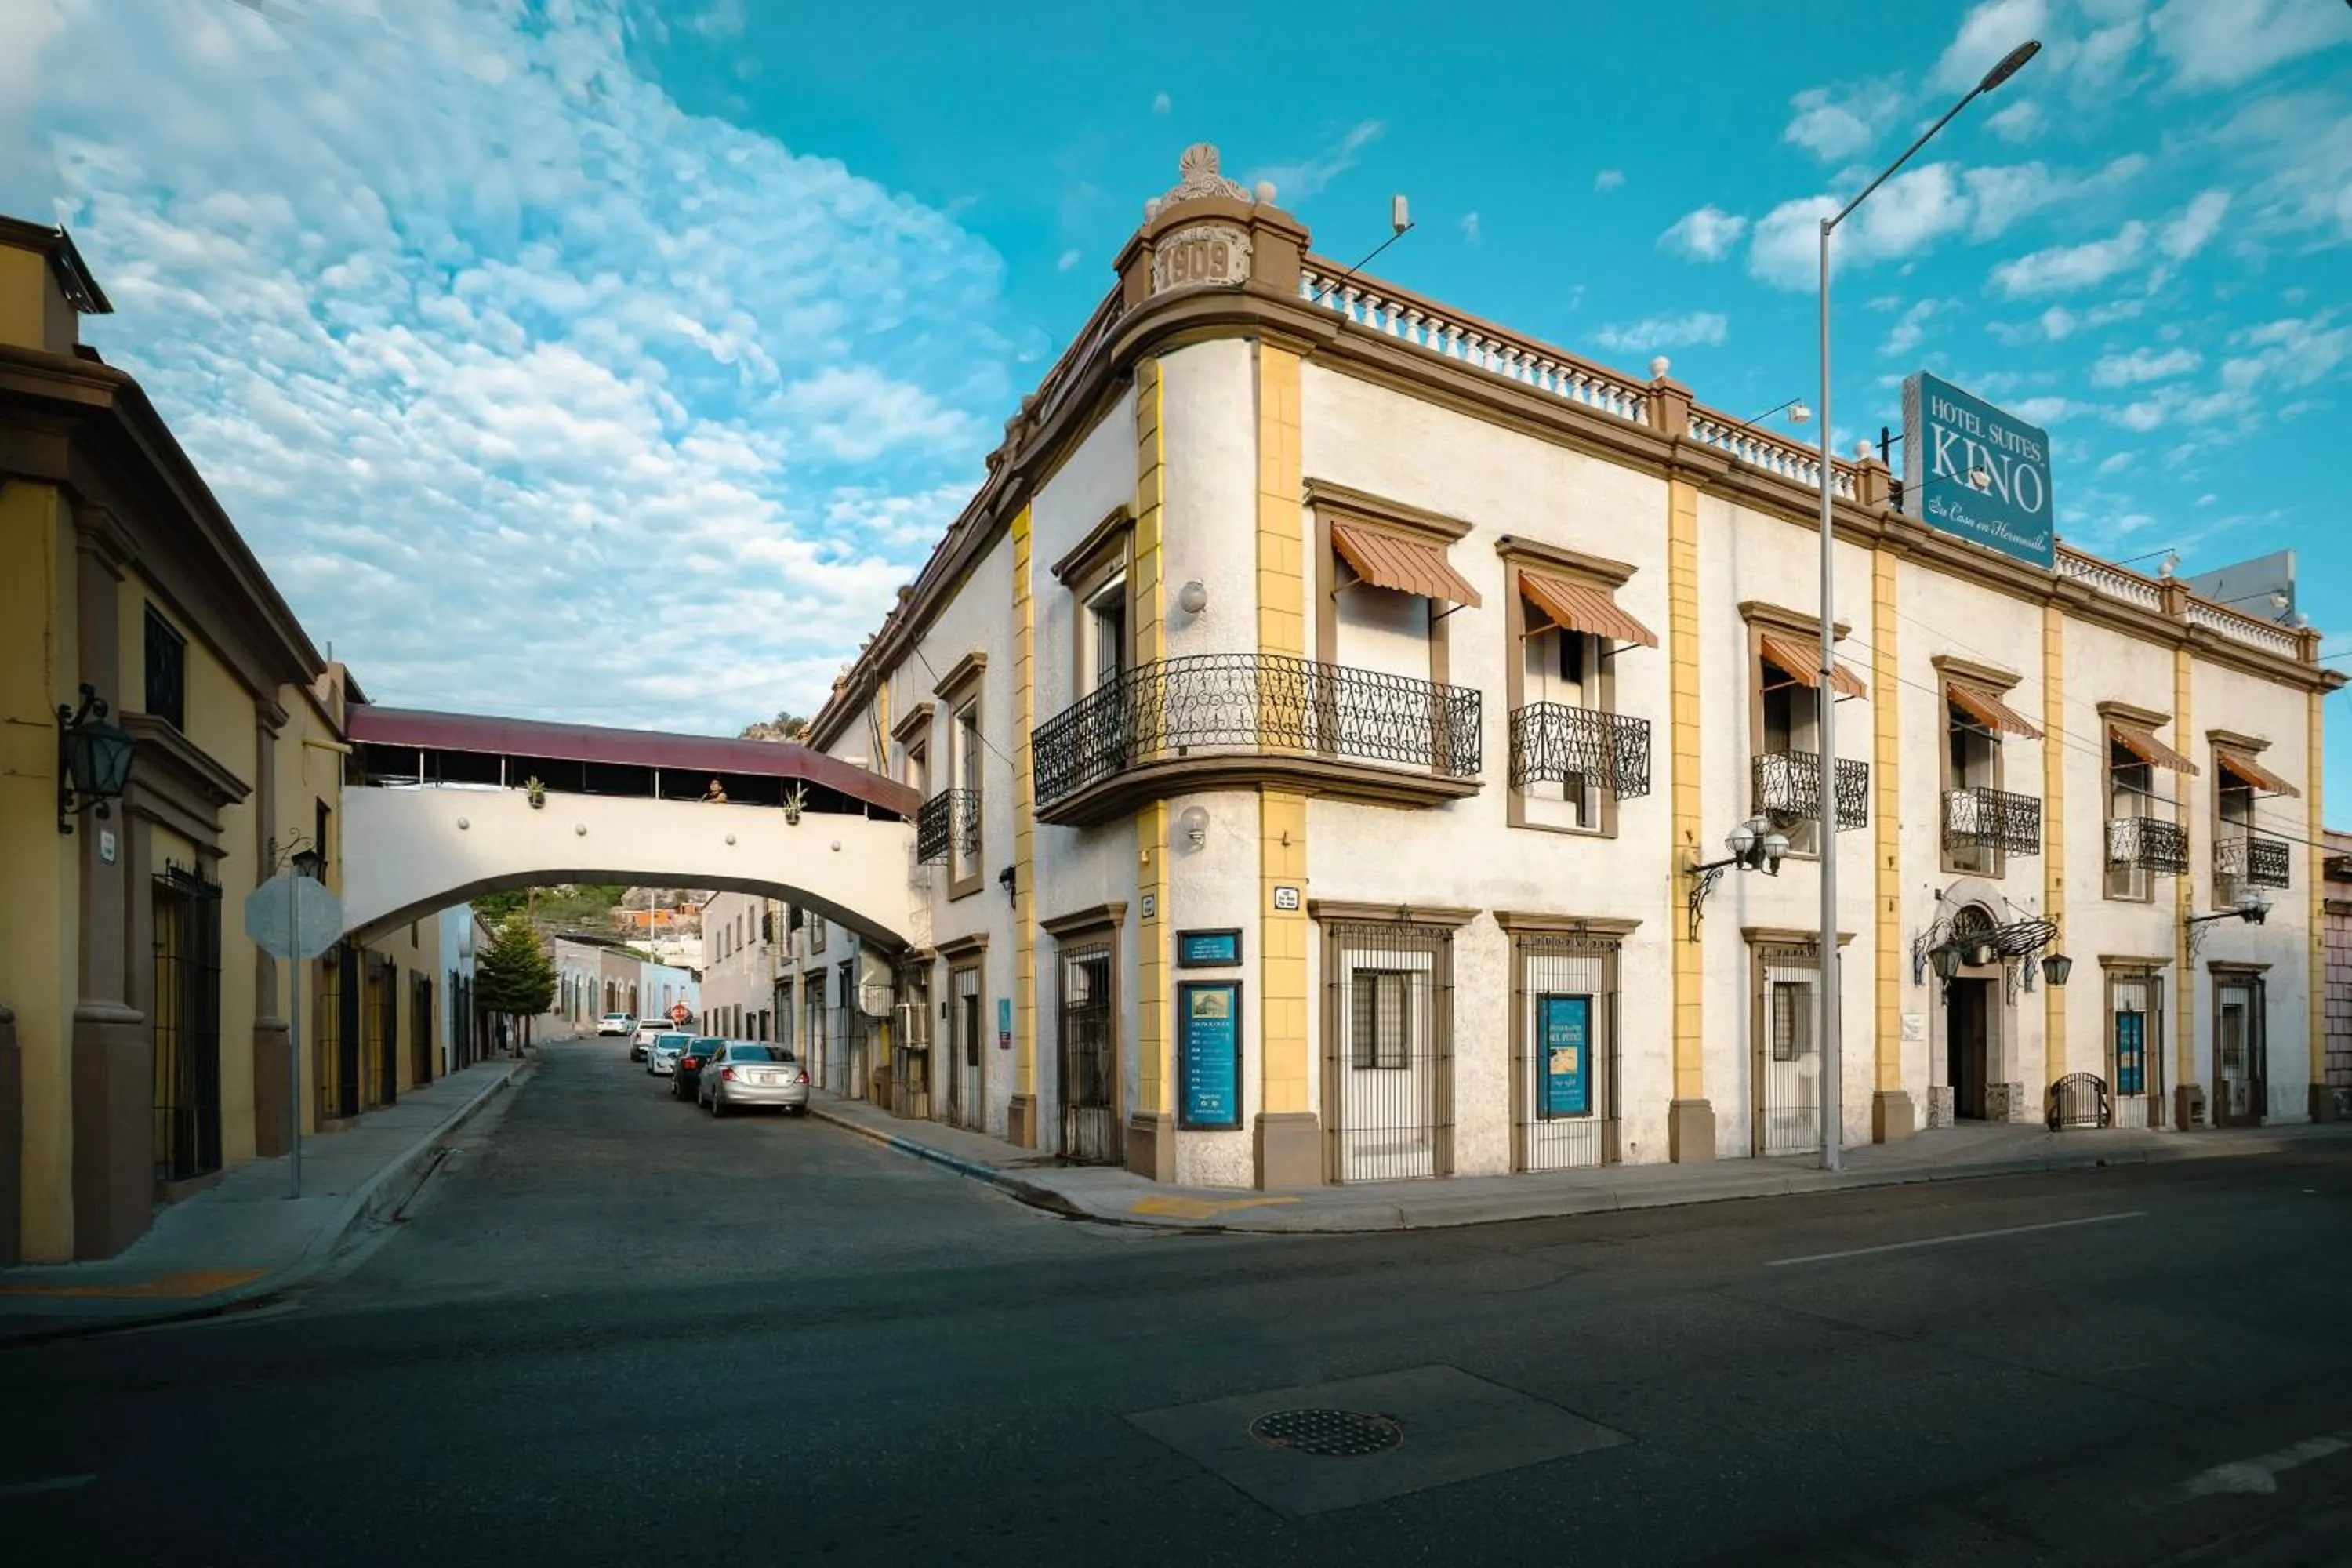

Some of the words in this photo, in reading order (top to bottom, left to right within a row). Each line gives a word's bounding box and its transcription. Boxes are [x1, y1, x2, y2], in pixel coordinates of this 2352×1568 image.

[1163, 241, 1229, 287] 1909
[1931, 395, 1986, 439] HOTEL
[1989, 423, 2041, 462] SUITES
[1931, 423, 2043, 514] KINO
[1949, 502, 1975, 528] Casa
[1976, 521, 1989, 533] en
